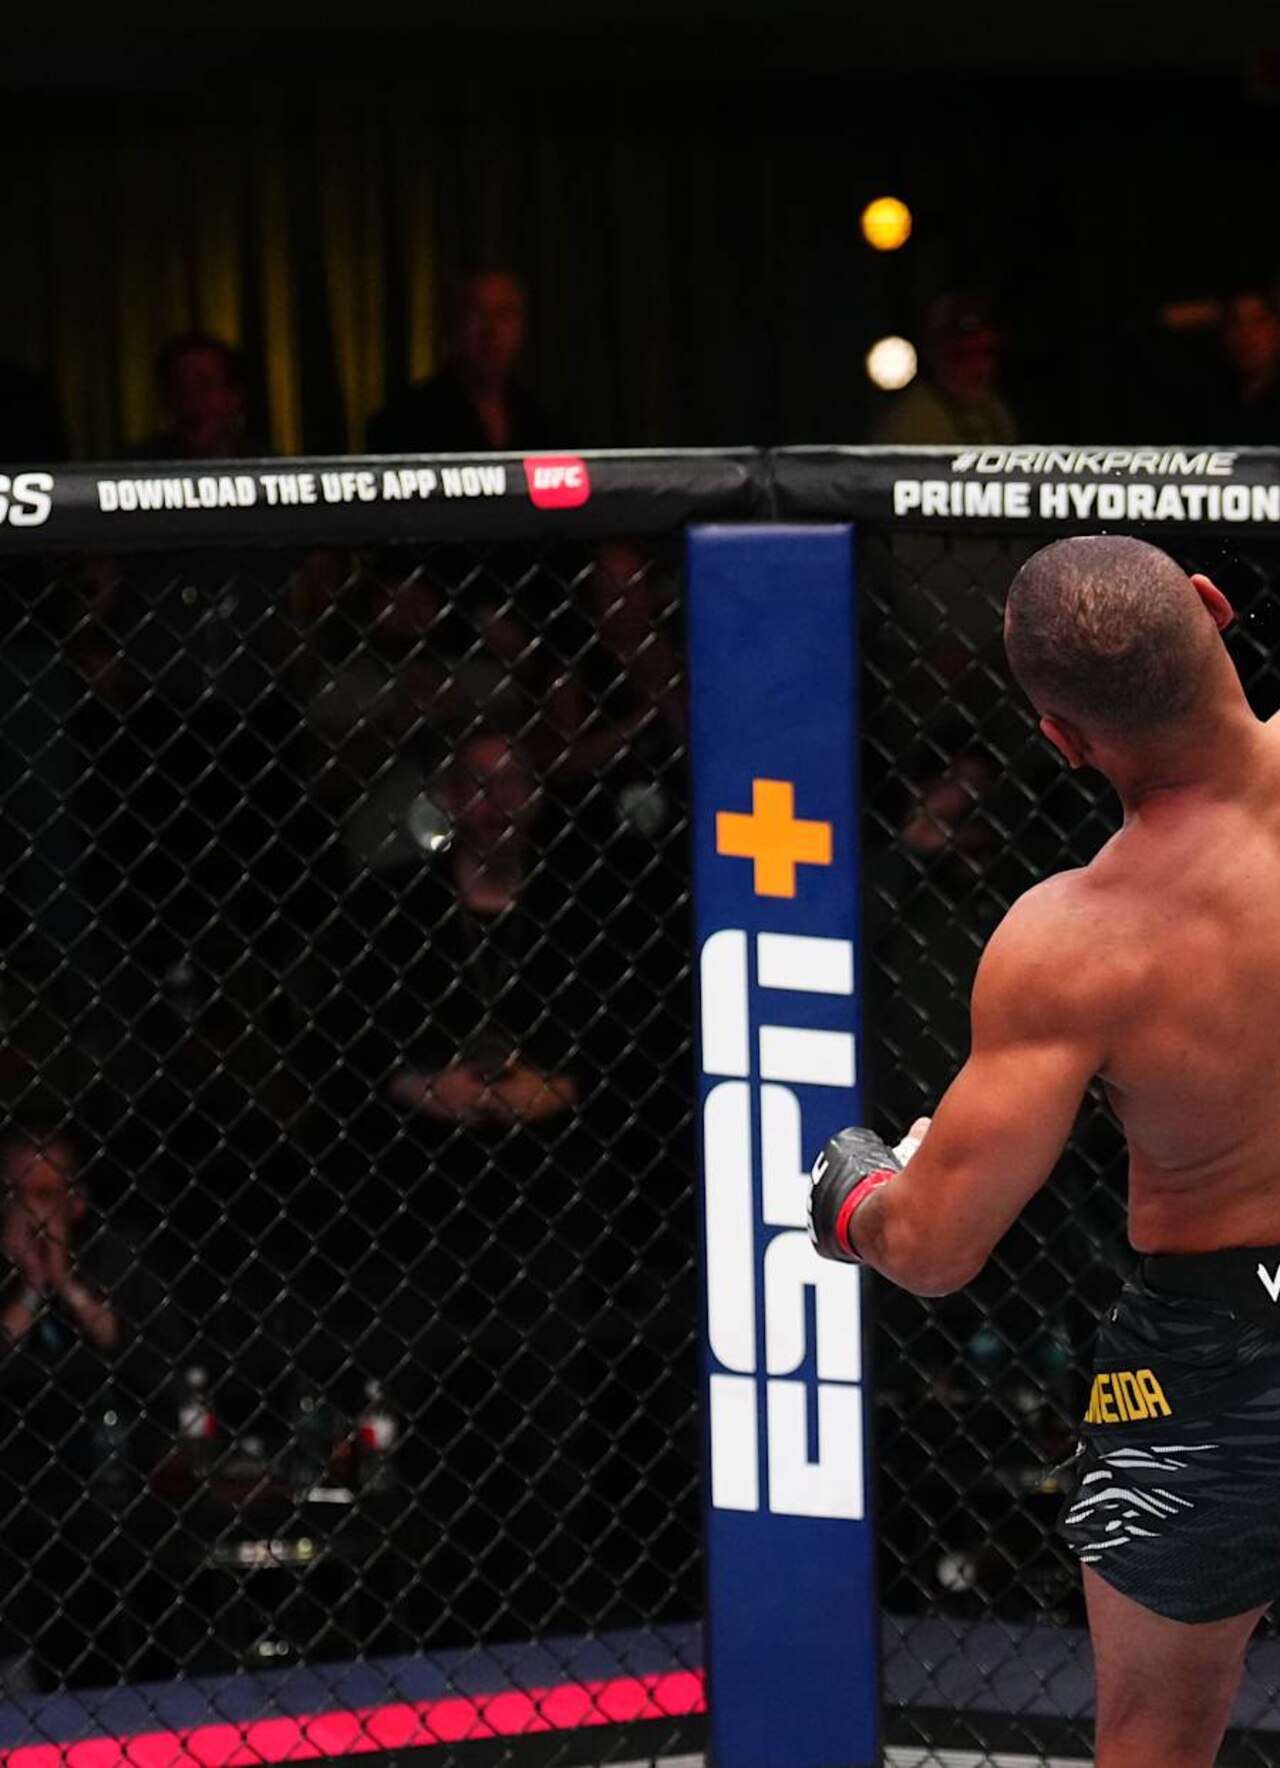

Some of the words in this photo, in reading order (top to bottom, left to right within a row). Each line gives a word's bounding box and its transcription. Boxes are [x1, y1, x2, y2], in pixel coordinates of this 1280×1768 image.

[532, 465, 583, 490] UFC
[951, 450, 1239, 476] #DRINKPRIME
[97, 476, 257, 512] DOWNLOAD
[259, 473, 318, 506] THE
[321, 471, 377, 503] UFC
[382, 468, 437, 500] APP
[440, 465, 506, 498] NOW
[893, 480, 1032, 518] PRIME
